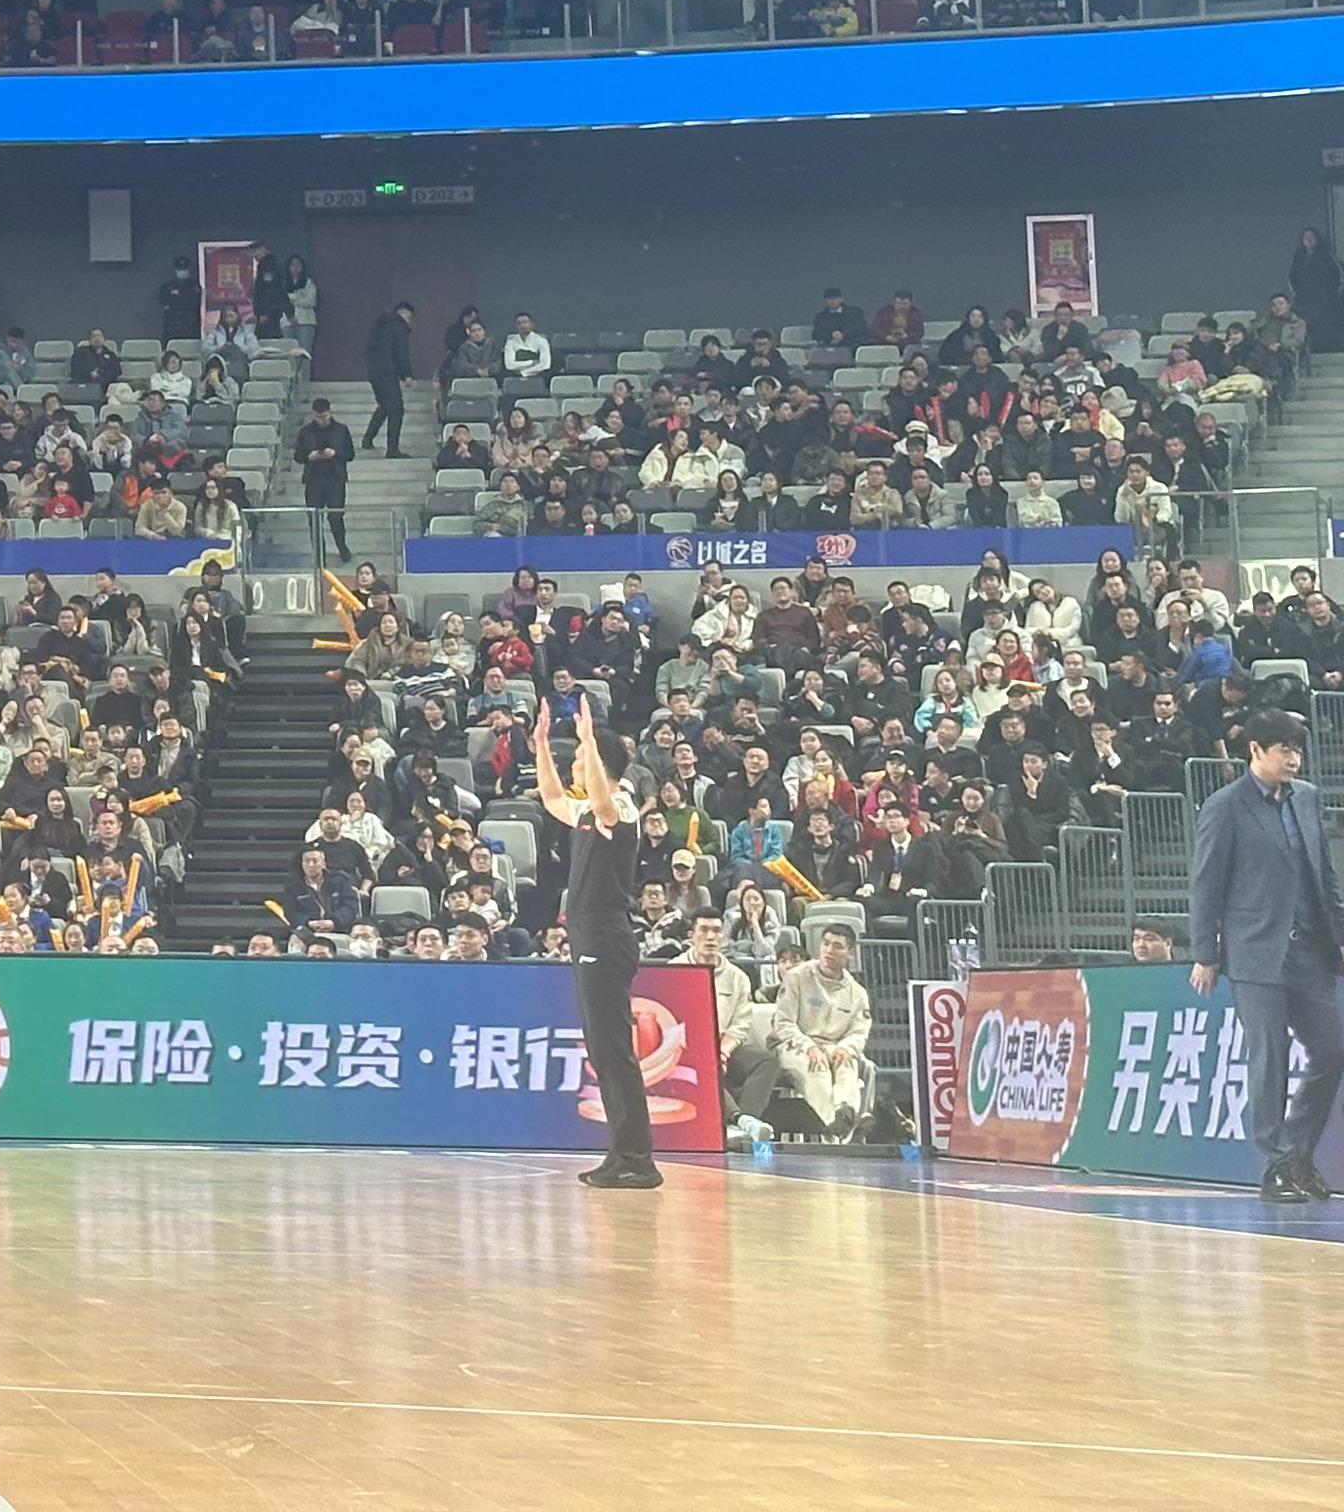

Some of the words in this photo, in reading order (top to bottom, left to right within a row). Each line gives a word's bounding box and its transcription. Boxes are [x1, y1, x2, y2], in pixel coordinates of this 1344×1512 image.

[1005, 1027, 1072, 1077] 中国人寿
[999, 1086, 1035, 1112] CHINA
[1038, 1088, 1065, 1112] LIFE
